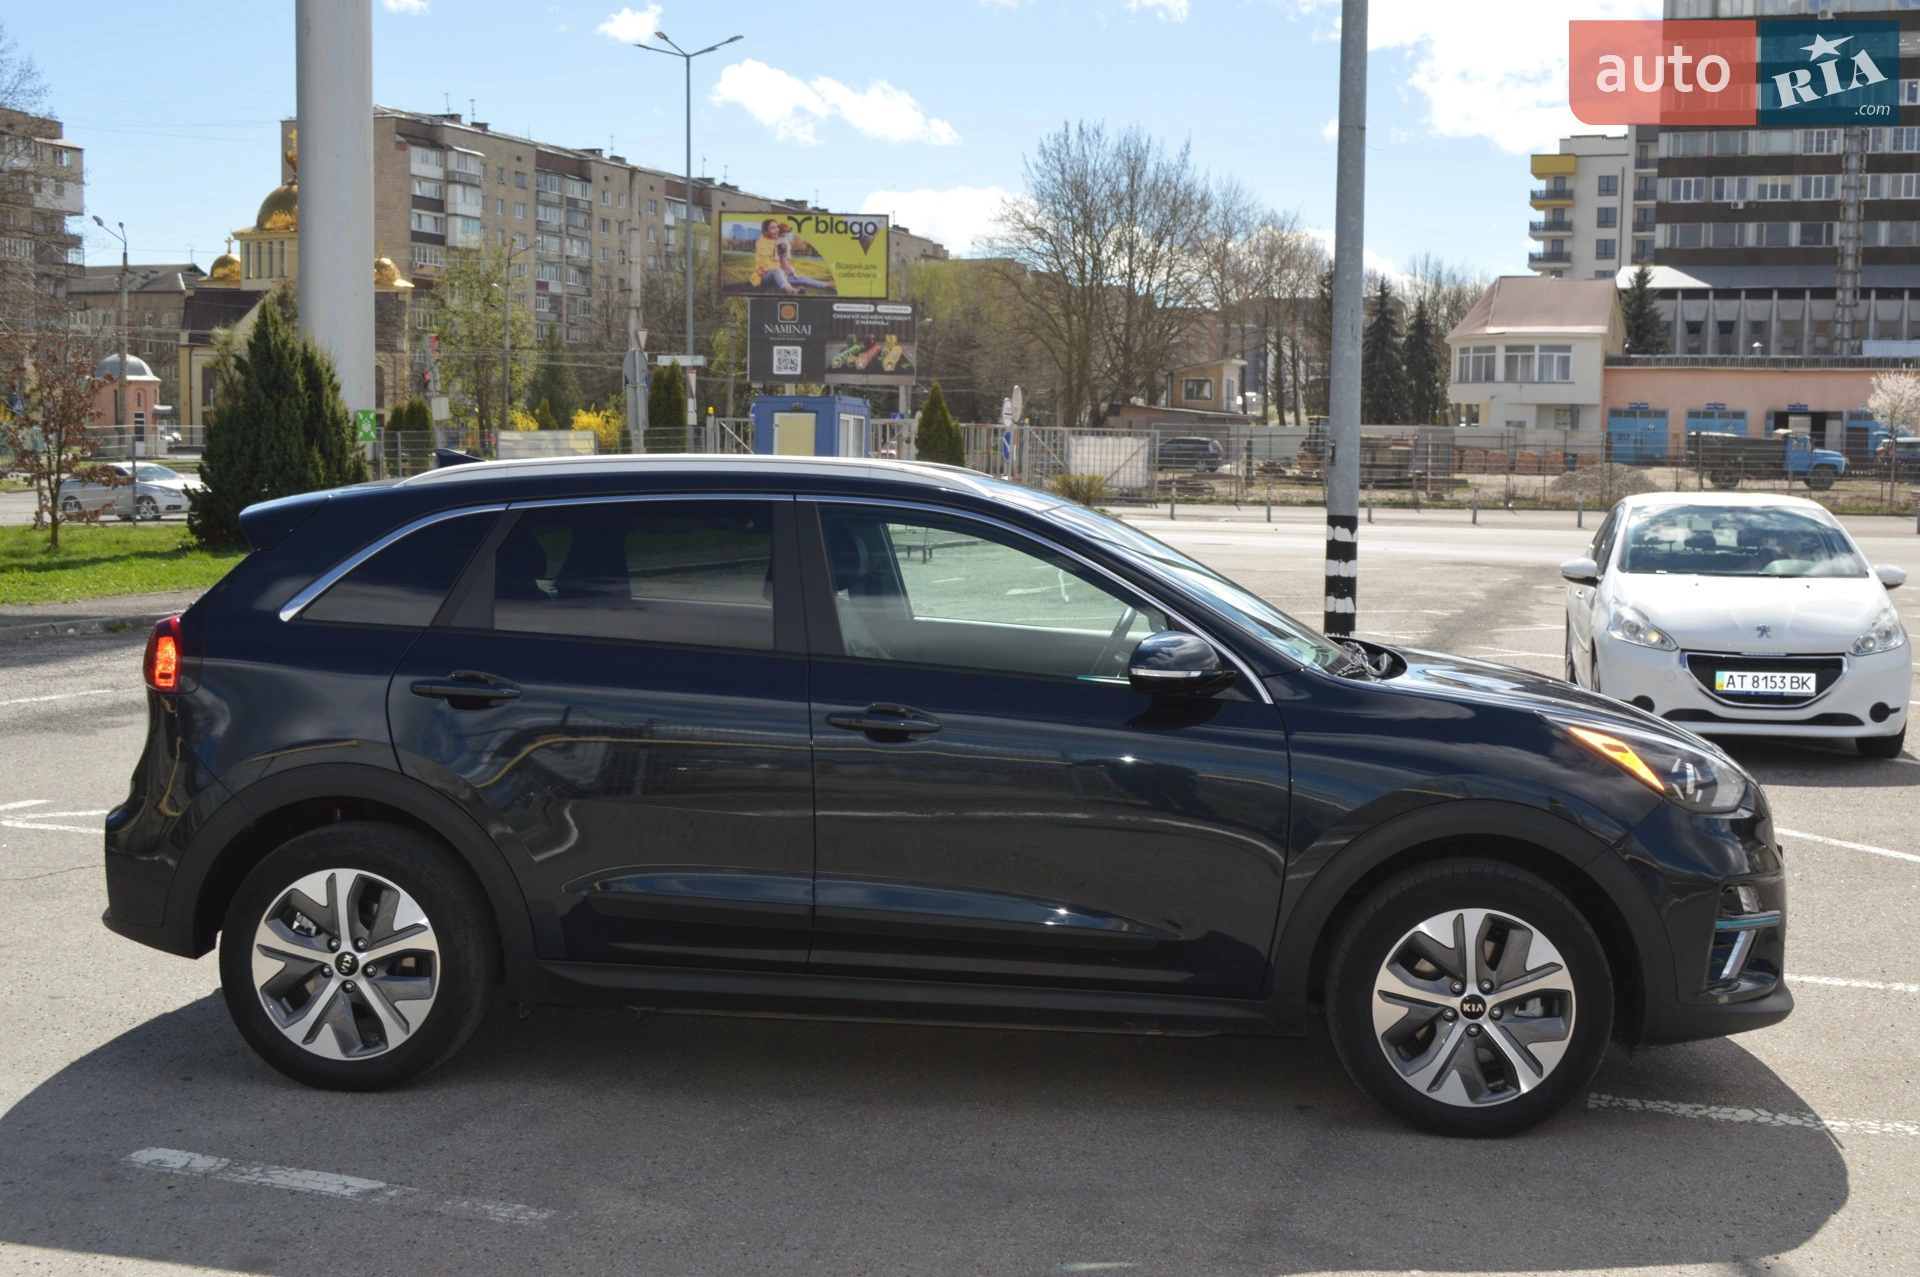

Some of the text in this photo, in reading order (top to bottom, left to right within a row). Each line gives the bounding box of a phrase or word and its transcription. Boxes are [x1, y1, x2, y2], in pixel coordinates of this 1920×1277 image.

[815, 216, 878, 240] blago
[764, 324, 812, 336] NAMINAJ
[1726, 674, 1811, 690] AT 8153 BK
[340, 954, 353, 973] KIA
[1463, 1003, 1484, 1012] KIA
